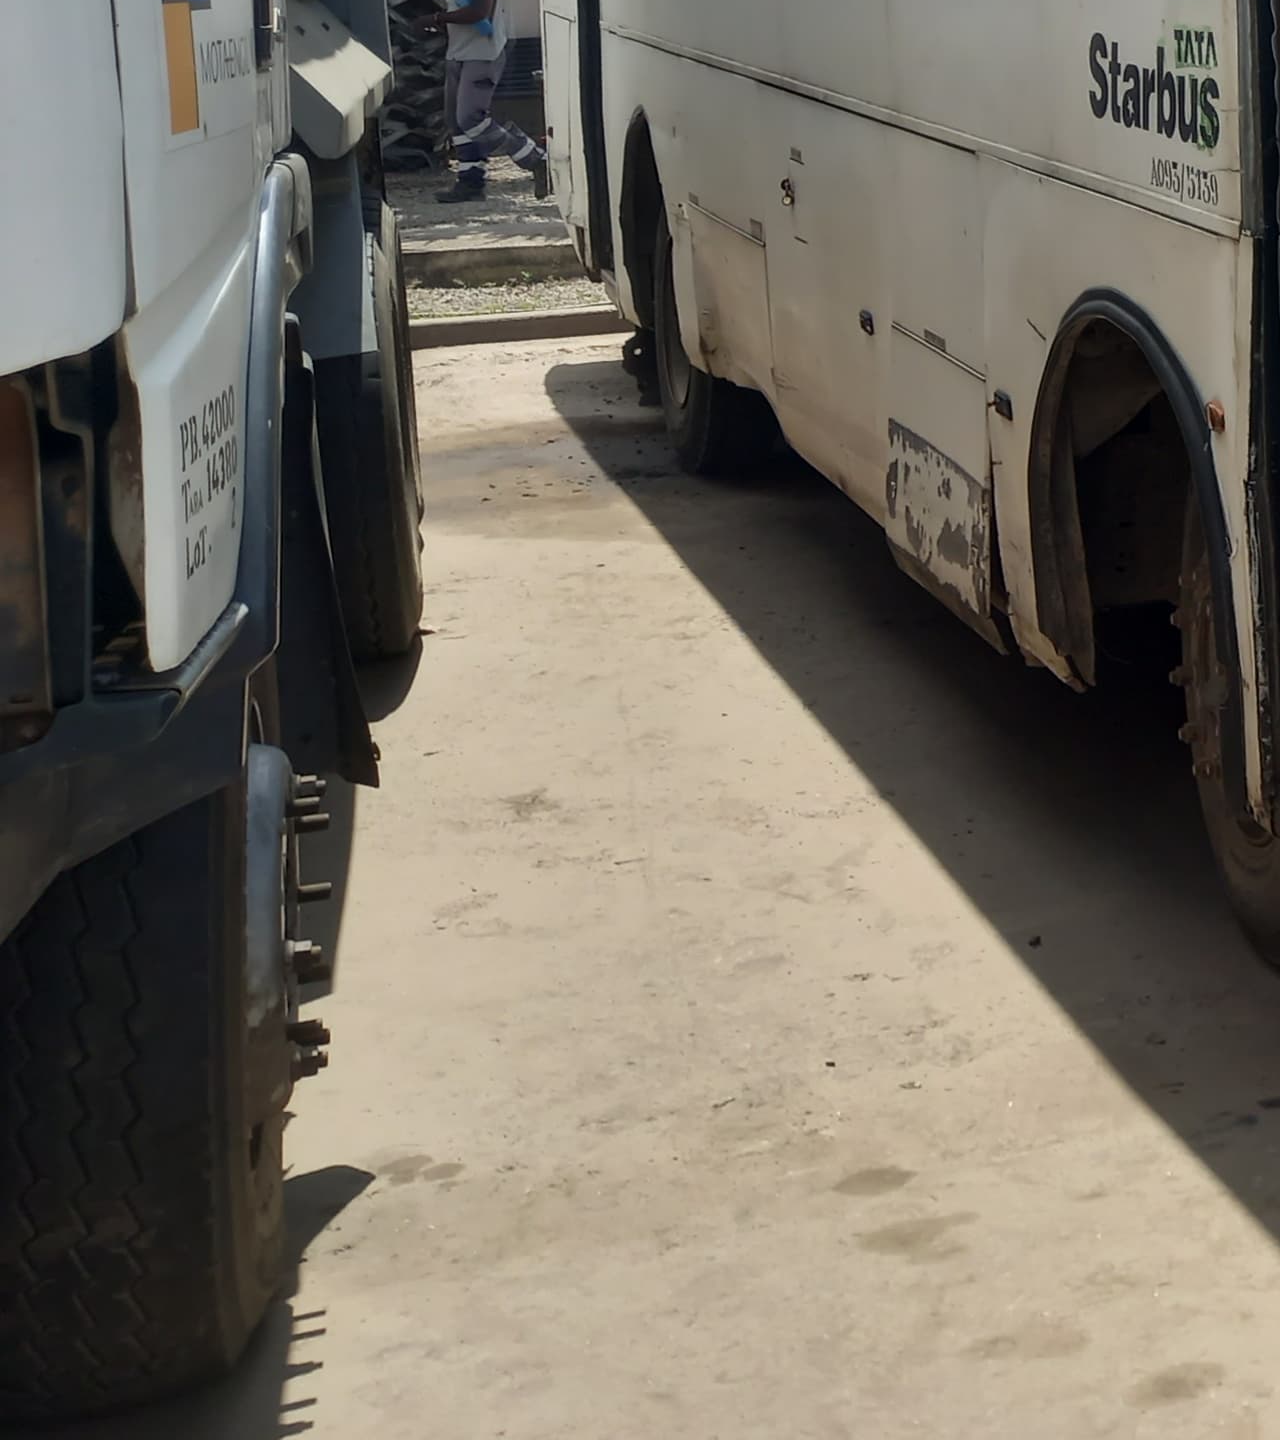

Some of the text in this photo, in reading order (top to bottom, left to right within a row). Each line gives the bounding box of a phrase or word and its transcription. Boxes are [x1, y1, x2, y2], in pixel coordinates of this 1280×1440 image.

[1174, 29, 1218, 67] TATA
[1089, 32, 1220, 149] Starbus
[206, 433, 238, 502] 14380
